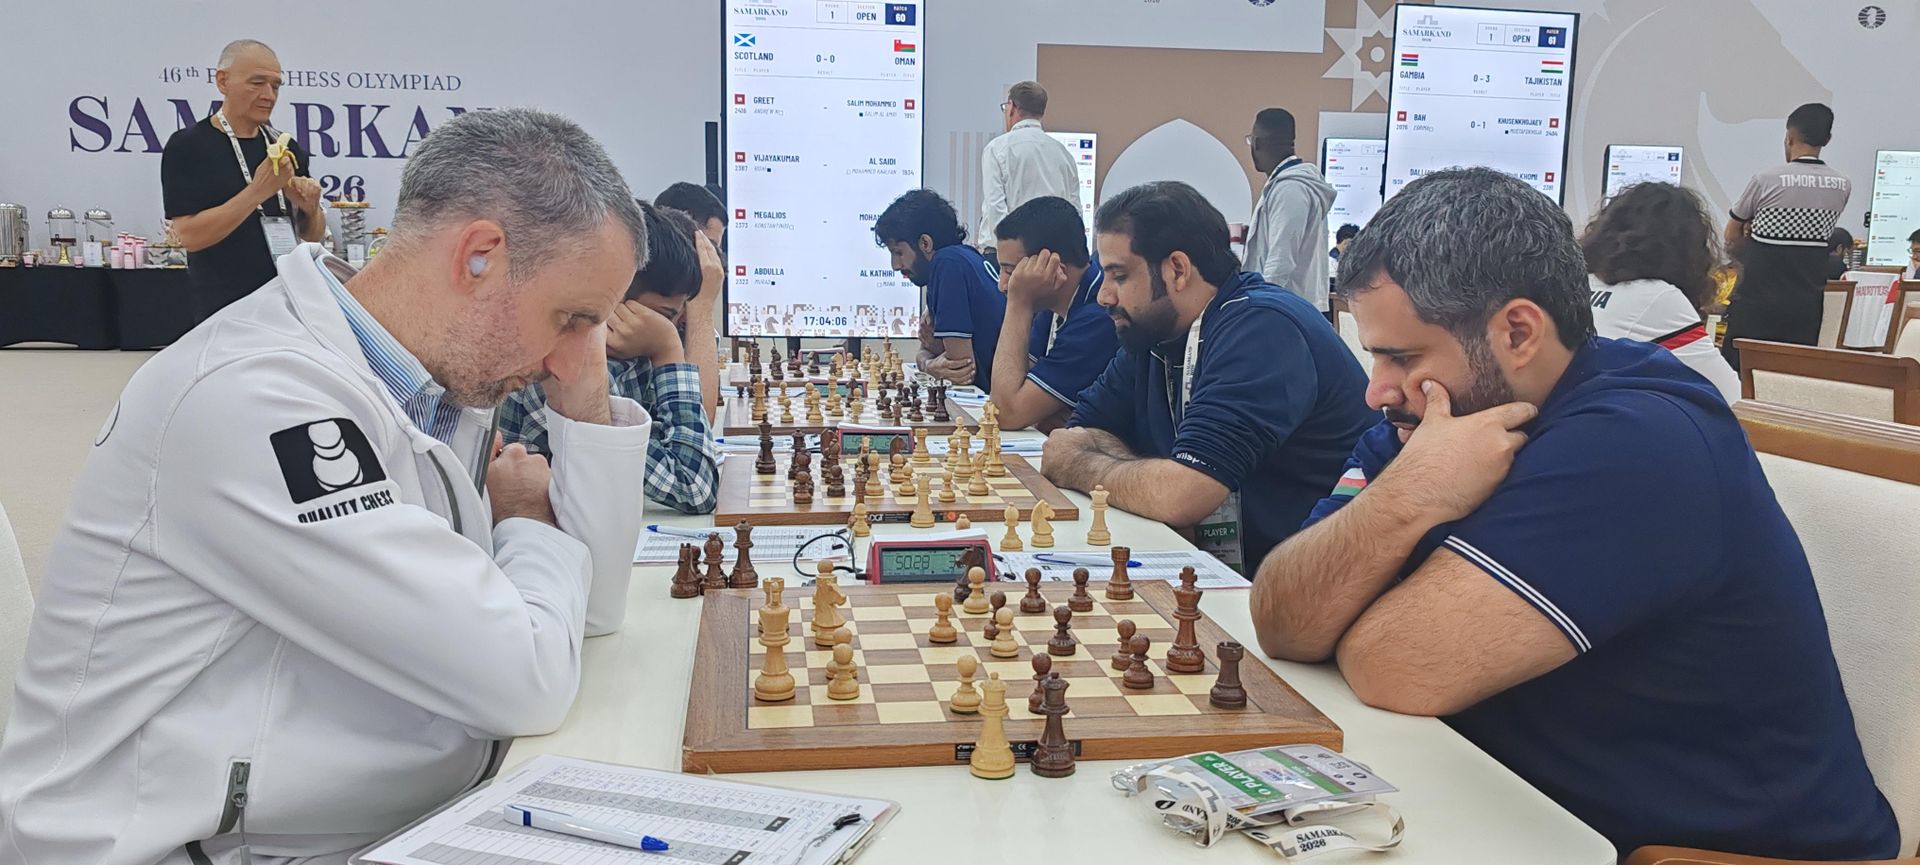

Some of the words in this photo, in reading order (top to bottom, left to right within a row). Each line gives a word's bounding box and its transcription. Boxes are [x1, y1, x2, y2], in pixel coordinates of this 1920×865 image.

[733, 7, 788, 17] SAMARKAND
[830, 11, 834, 20] 1
[856, 12, 877, 21] OPEN
[895, 13, 906, 23] 60
[1402, 29, 1452, 38] SAMARKAND
[1512, 34, 1531, 43] OPEN
[734, 51, 774, 61] SCOTLAND
[816, 54, 821, 63] 0
[829, 55, 835, 63] 0
[894, 57, 916, 66] OMAN
[158, 66, 181, 84] 46
[186, 67, 199, 78] th
[346, 72, 462, 91] OLYMPIAD
[1399, 71, 1425, 80] GAMBIA
[1473, 74, 1479, 82] 0
[1485, 75, 1490, 83] 3
[1525, 76, 1563, 86] TAJIKISTAN
[753, 96, 775, 105] GREET
[847, 99, 864, 107] SALIM
[865, 100, 897, 108] MOHAMMED
[1498, 118, 1542, 126] KHUSENKHOJAEV
[68, 95, 495, 160] SARKA
[753, 154, 800, 163] VIJAYAKUMAR
[1779, 174, 1816, 188] TIMOR
[1818, 175, 1847, 191] LESTE
[320, 174, 366, 202] 26
[753, 211, 787, 219] MEGALIOS
[754, 268, 785, 276] ABDULLA
[803, 316, 848, 327] 17:04:06
[297, 498, 358, 524] QUALITY
[360, 489, 395, 511] CHESS
[1203, 528, 1228, 538] PLAYER
[1211, 761, 1258, 789] PLAYER
[1299, 838, 1327, 853] 2026
